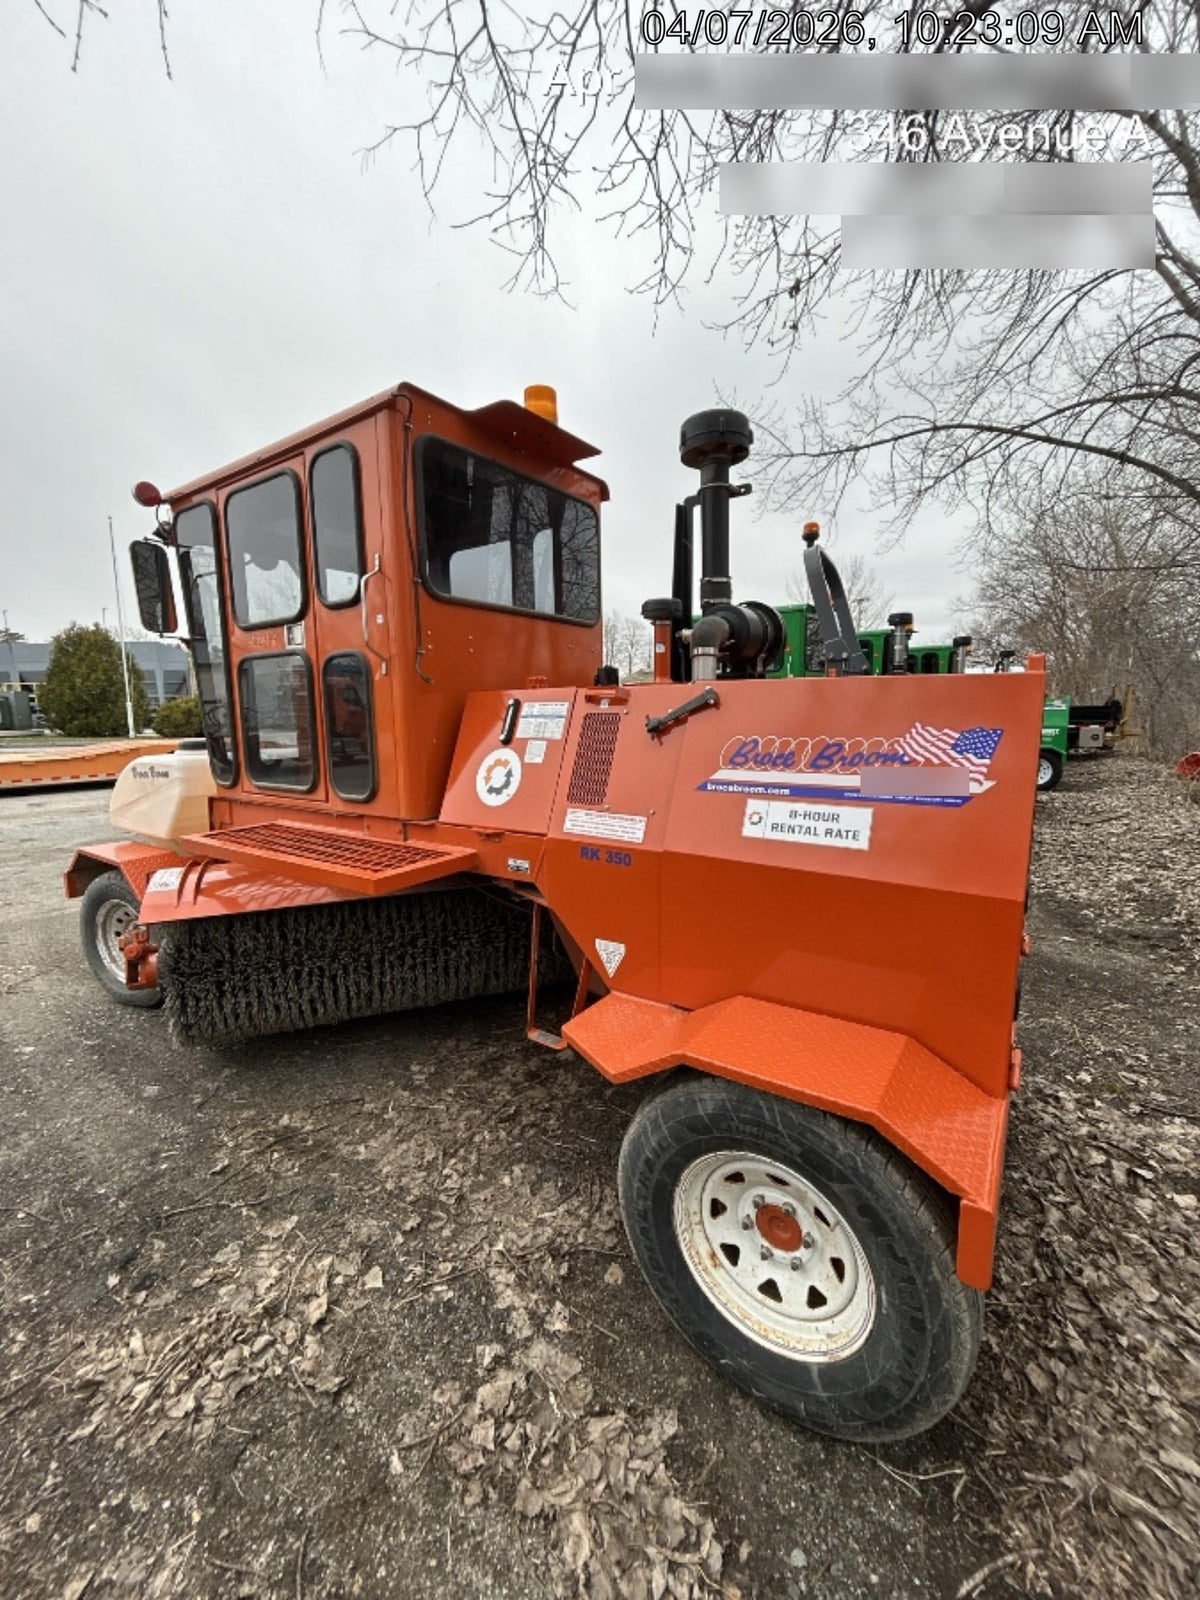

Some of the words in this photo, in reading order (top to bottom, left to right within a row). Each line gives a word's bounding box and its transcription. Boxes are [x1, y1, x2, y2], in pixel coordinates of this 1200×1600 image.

[728, 738, 797, 768] Broce
[788, 809, 841, 823] 8-HOUR
[770, 822, 820, 836] RENTAL
[824, 827, 861, 841] RATE
[606, 850, 632, 866] 350
